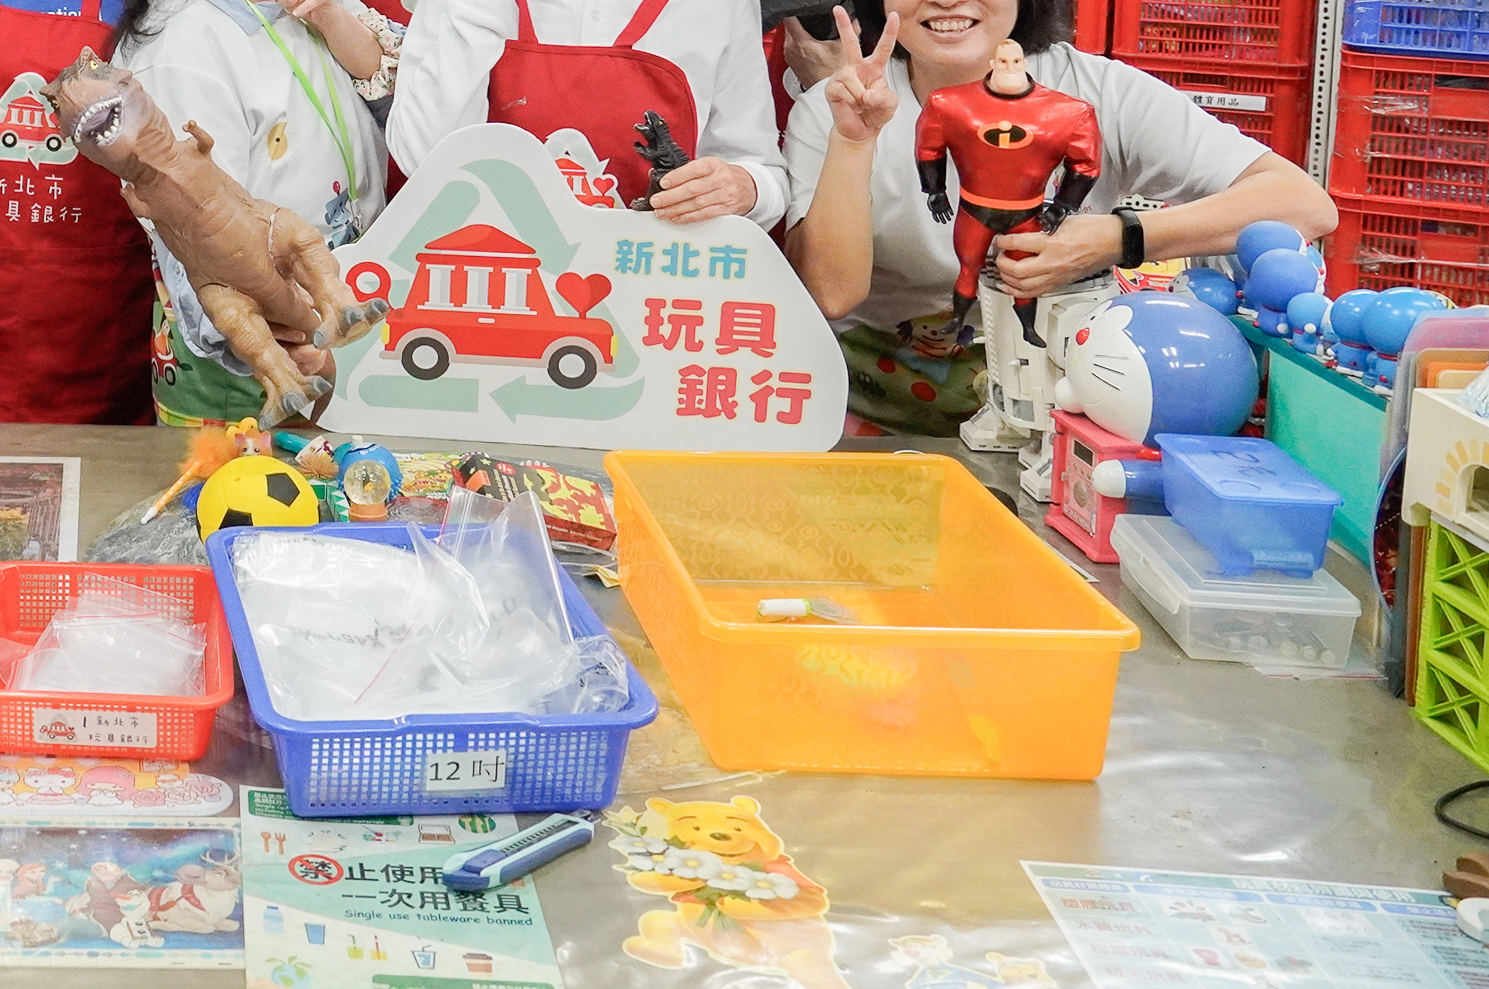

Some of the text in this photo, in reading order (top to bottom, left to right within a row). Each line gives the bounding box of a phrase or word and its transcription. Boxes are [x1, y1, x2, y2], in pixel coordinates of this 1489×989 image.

[614, 238, 749, 281] 新北市
[641, 297, 778, 359] 玩具
[675, 362, 813, 426] 銀行
[96, 715, 139, 728] 新北市
[88, 732, 149, 744] 玩具銀行
[428, 755, 505, 783] 12 吋
[299, 859, 444, 883] 禁止使用
[341, 887, 530, 915] 一次用餐具
[344, 909, 534, 927] Single use tableware banned
